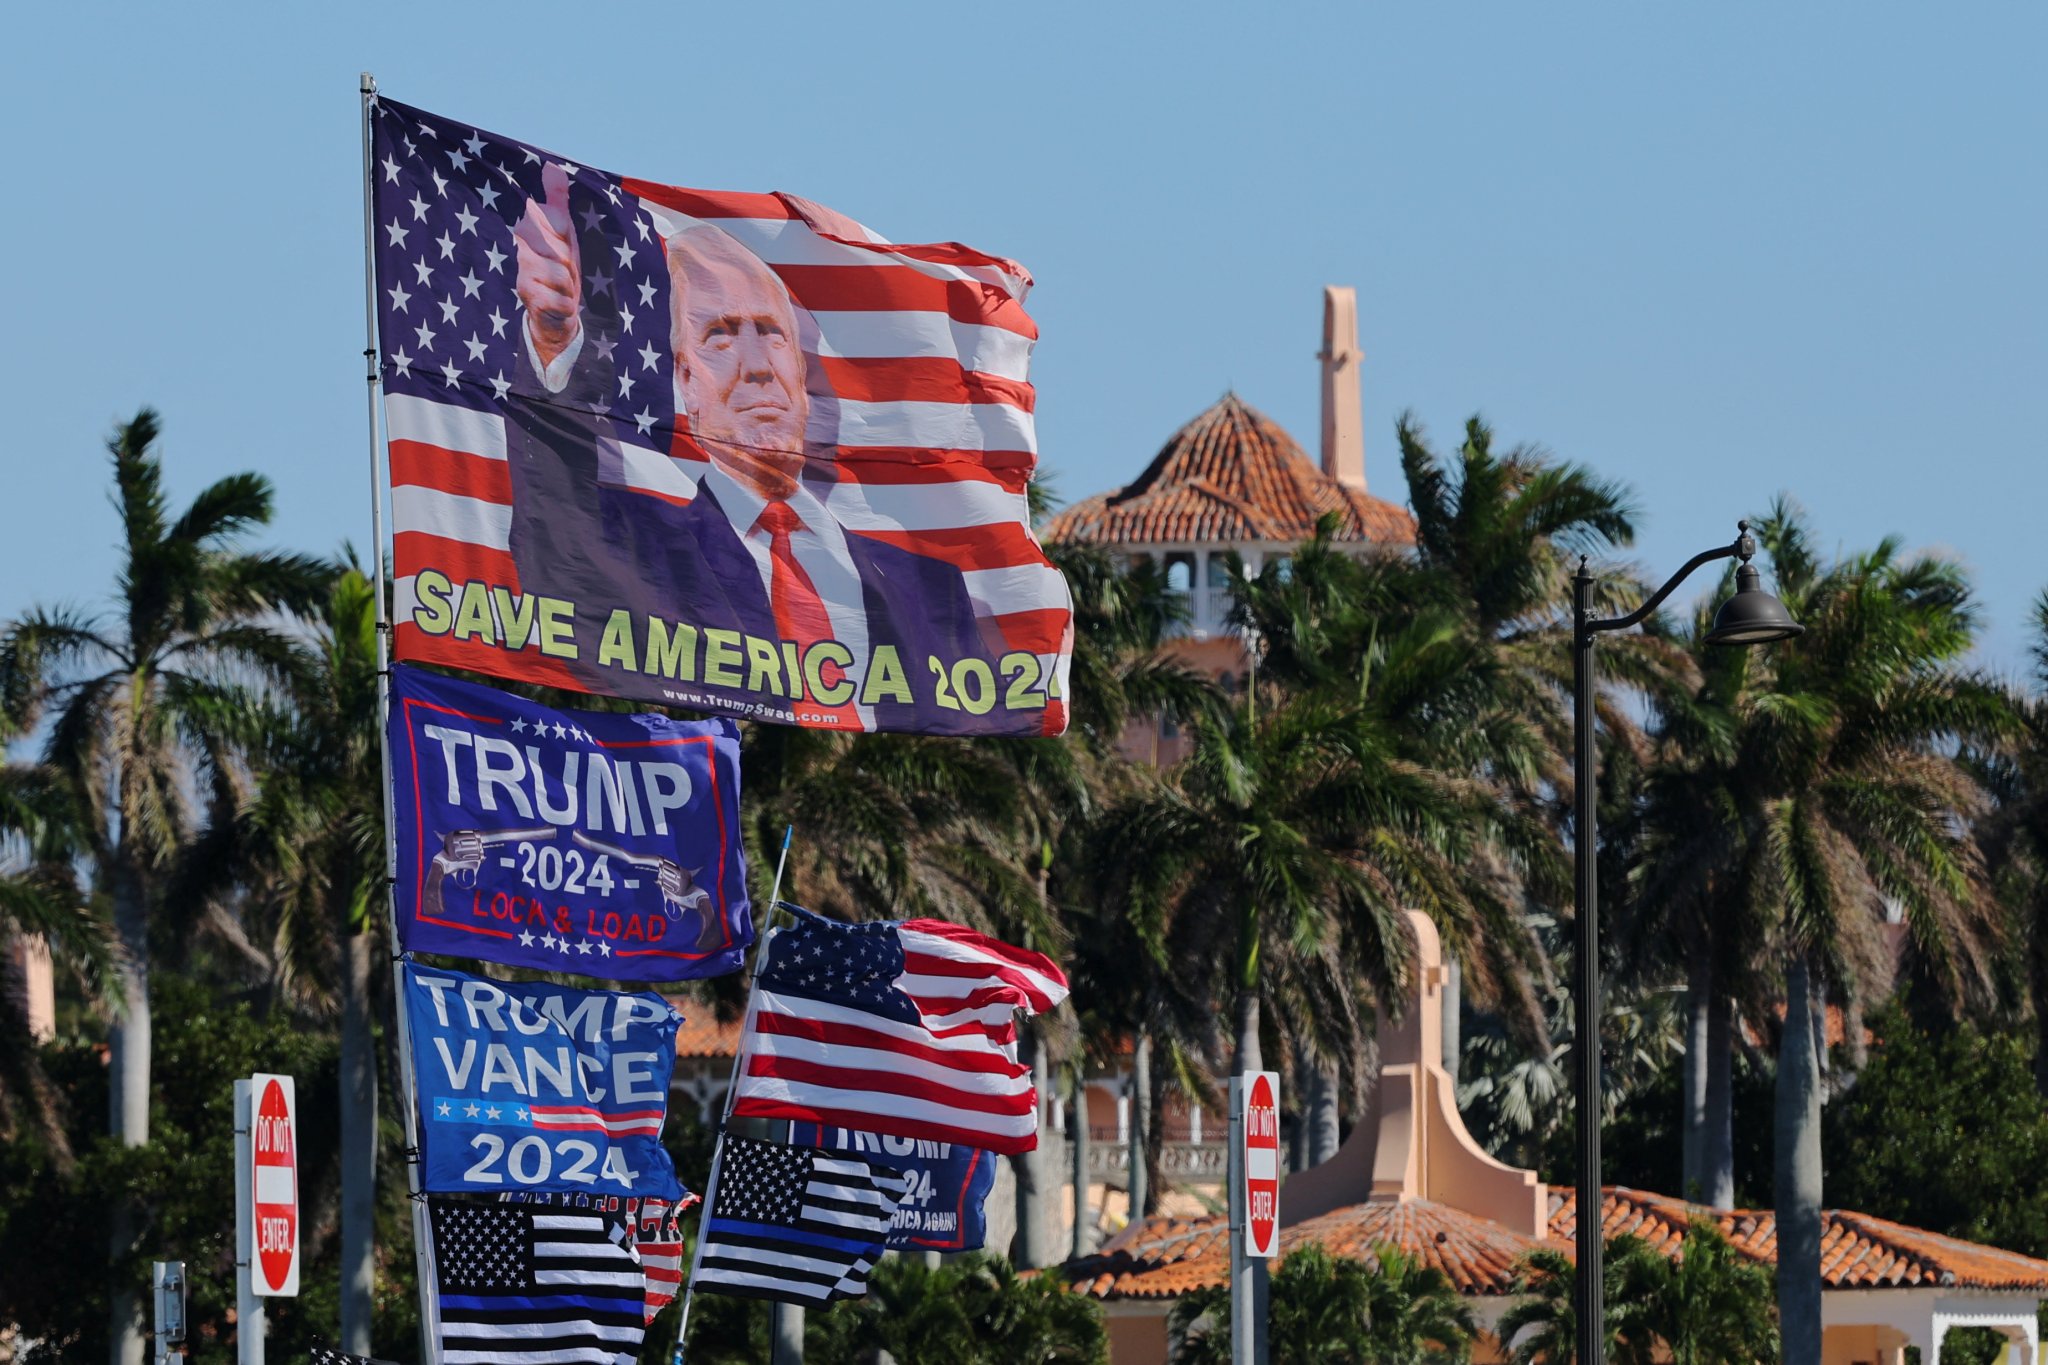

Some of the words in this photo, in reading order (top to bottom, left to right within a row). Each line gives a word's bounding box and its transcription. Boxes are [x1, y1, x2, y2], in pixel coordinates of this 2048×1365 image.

[413, 569, 578, 661] SAVE
[599, 609, 914, 706] AMERICA
[663, 689, 839, 724] www.TrumpSwag.com
[424, 723, 693, 837] TRUMP
[472, 890, 547, 927] LOCK
[553, 905, 574, 934] &
[587, 908, 667, 942] LOAD
[415, 974, 670, 1043] TRUMP
[432, 1036, 665, 1105] VANCE
[258, 1118, 270, 1152] DO
[273, 1118, 290, 1153] NOT
[1248, 1109, 1259, 1136] DO
[1261, 1109, 1275, 1137] NOT
[463, 1132, 640, 1190] 2024
[889, 1208, 922, 1231] RICA
[922, 1211, 958, 1232] AGAIN!
[1252, 1190, 1272, 1219] ENTER
[261, 1217, 289, 1251] ENTER
